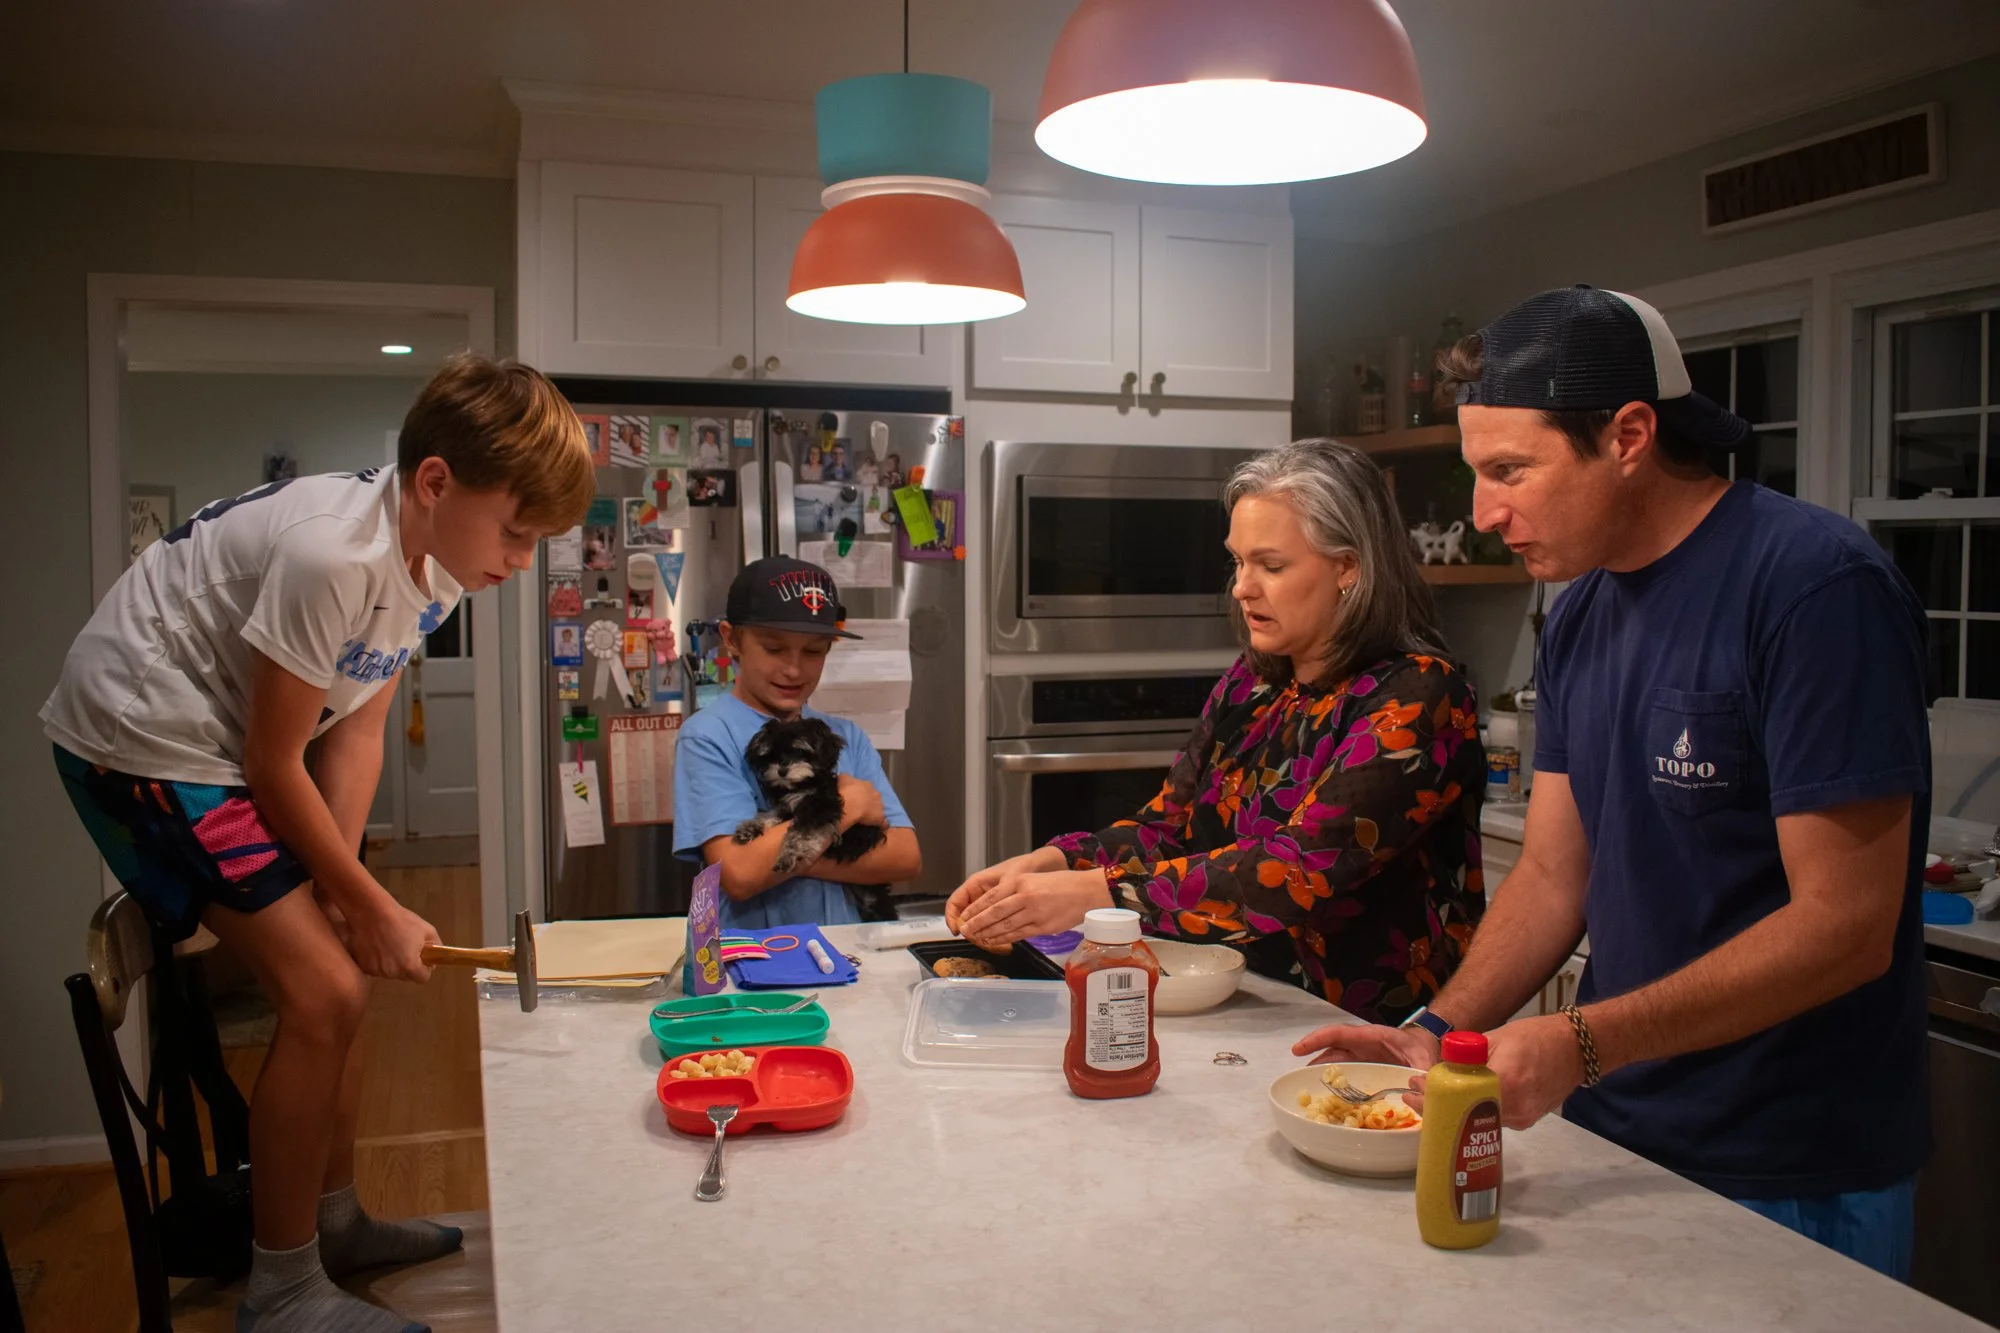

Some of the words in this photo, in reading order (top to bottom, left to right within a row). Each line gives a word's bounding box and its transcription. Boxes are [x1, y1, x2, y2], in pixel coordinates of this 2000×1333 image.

[611, 718, 633, 732] ALL
[636, 717, 661, 730] OUT
[664, 716, 682, 728] OF
[1655, 756, 1716, 778] TOPO
[1470, 1129, 1498, 1145] SPICY
[1463, 1141, 1500, 1158] BROWN
